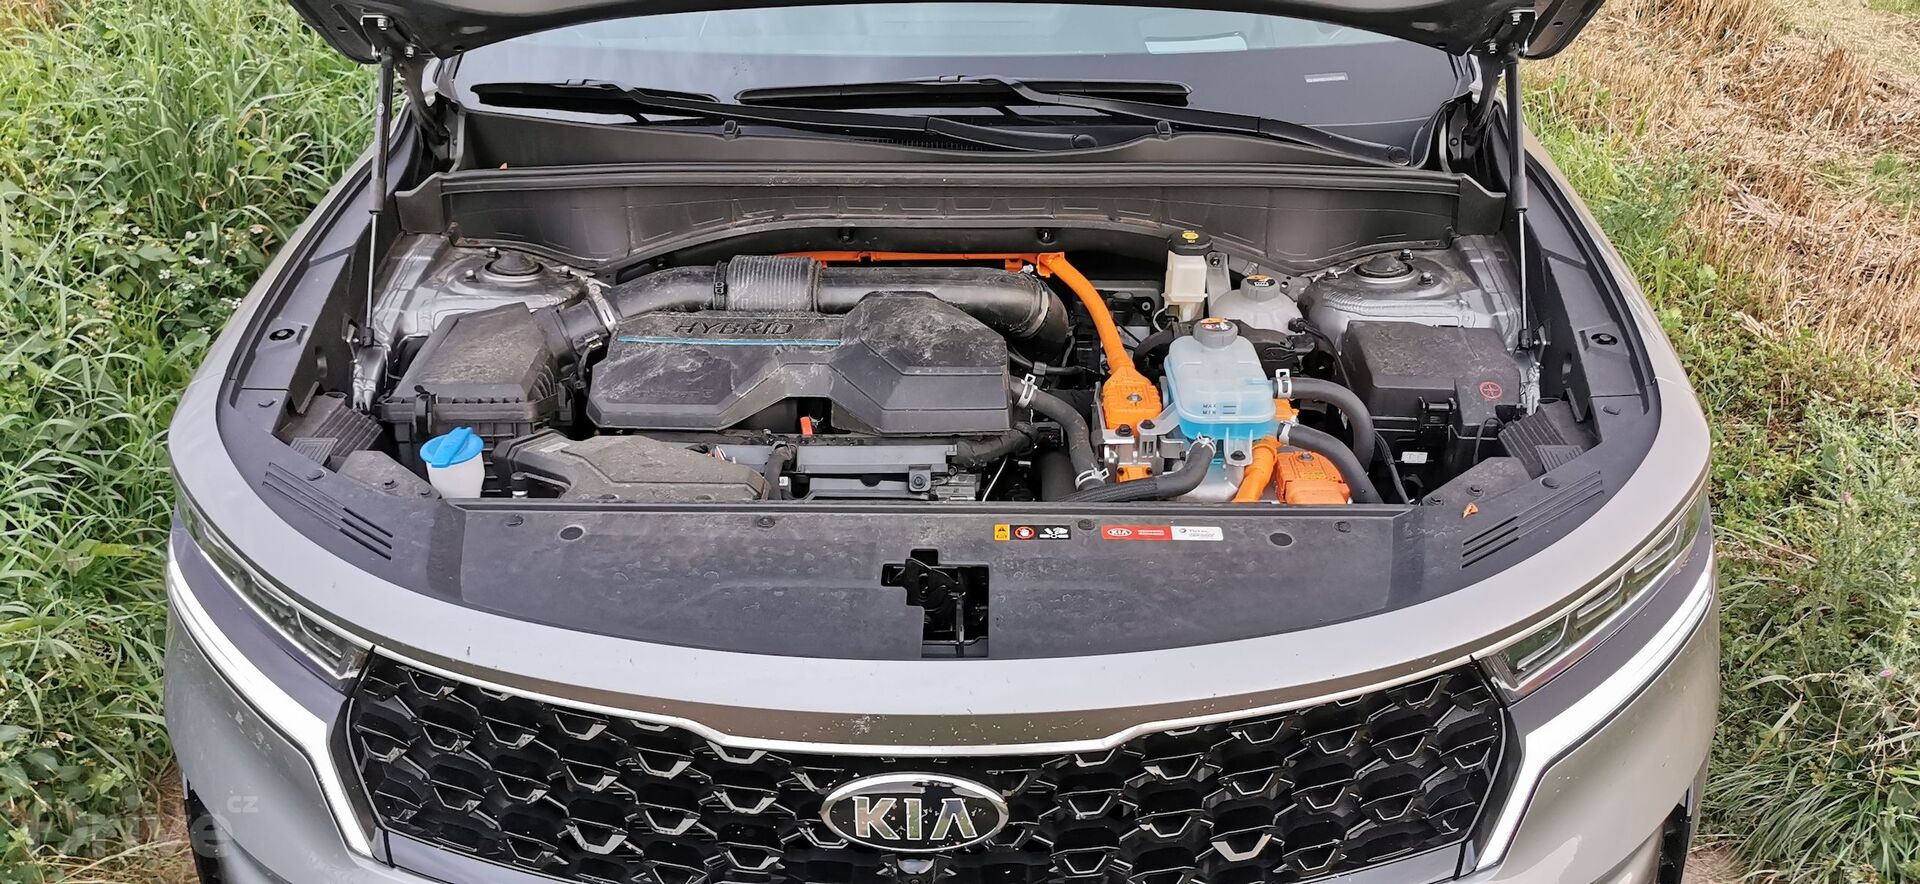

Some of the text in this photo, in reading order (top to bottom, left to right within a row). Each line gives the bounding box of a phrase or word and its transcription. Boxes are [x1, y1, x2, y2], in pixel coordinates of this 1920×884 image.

[673, 320, 794, 336] HYBRID
[1108, 528, 1131, 536] KIA
[852, 796, 978, 840] KIA
